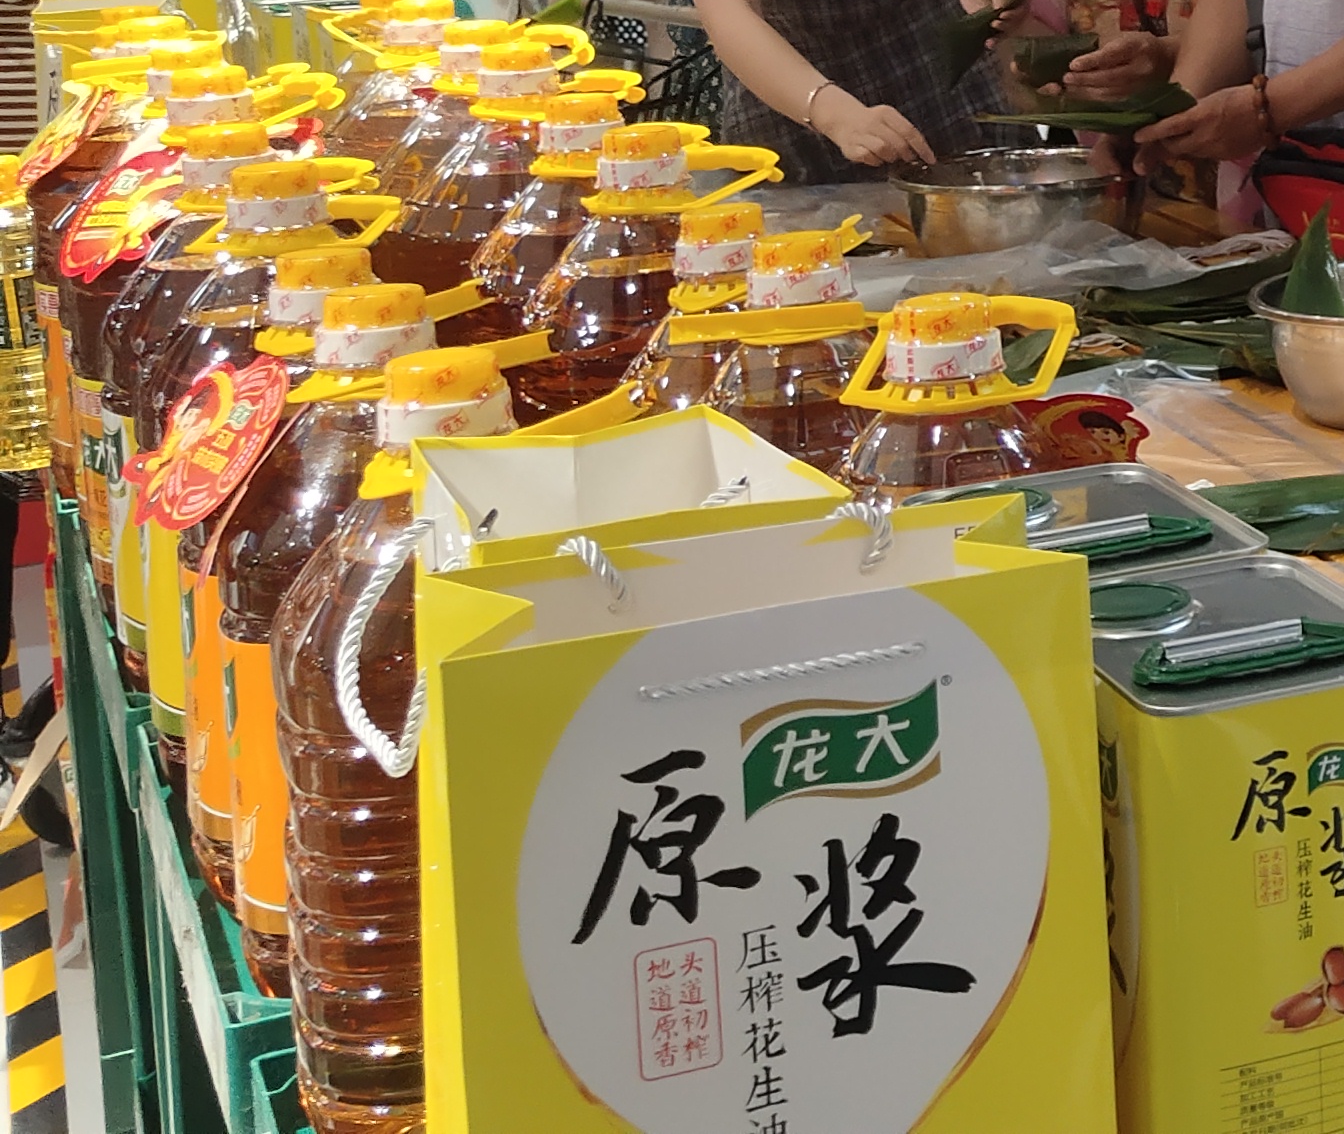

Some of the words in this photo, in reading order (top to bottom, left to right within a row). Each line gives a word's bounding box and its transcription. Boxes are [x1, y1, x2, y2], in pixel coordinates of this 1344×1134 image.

[773, 715, 911, 786] 龙大
[1297, 838, 1313, 941] 压榨花生油
[646, 958, 678, 1068] 地道原香
[679, 952, 709, 1063] 头道初榨
